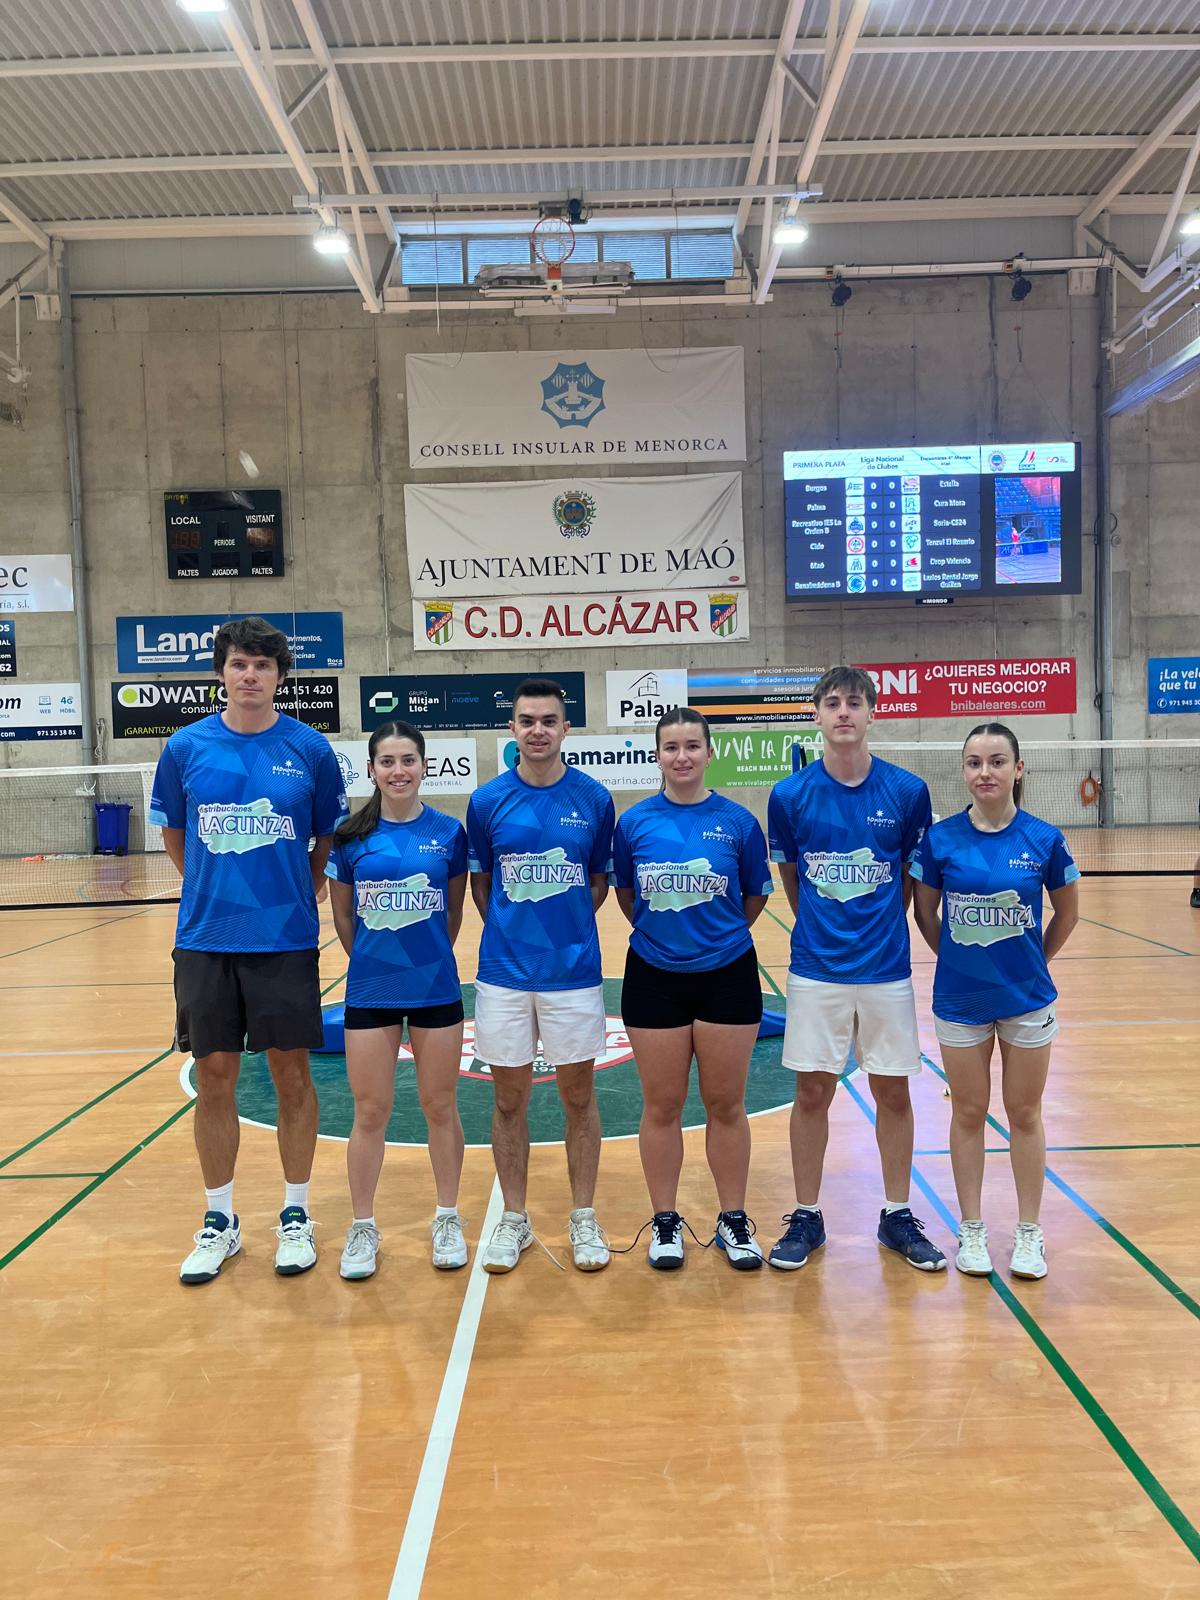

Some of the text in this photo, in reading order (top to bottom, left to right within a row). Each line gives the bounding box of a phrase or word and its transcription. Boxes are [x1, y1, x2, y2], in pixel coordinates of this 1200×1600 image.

[420, 438, 728, 457] CONSELL INSULAR DE MENORCA
[875, 455, 905, 463] Nacional
[171, 516, 201, 525] LOCAL
[245, 514, 275, 524] VISITANT
[417, 539, 735, 588] AJUNTAMENT DE MAÓ
[177, 569, 200, 577] FALTES
[211, 568, 239, 577] JUGADOR
[251, 567, 274, 575] FALTES
[464, 605, 532, 638] C.D.
[540, 595, 699, 638] ALCÁZAR
[136, 624, 220, 652] Land
[783, 666, 826, 674] inmobiliarios
[924, 661, 1071, 681] ¿QUIERES MEJORAR
[312, 684, 333, 694] 420
[949, 680, 1047, 695] TU NEGOCIO?
[1159, 679, 1197, 693] que tu
[60, 695, 74, 705] 4G
[408, 696, 440, 705] Mitjan
[950, 699, 1046, 711] bnibaleares.com
[409, 705, 429, 713] Lloc
[710, 735, 754, 761] VIVA
[761, 739, 776, 759] LA
[199, 815, 294, 837] LACUNZA
[501, 863, 585, 885] LACUNZA
[639, 873, 728, 896] LACUNZA
